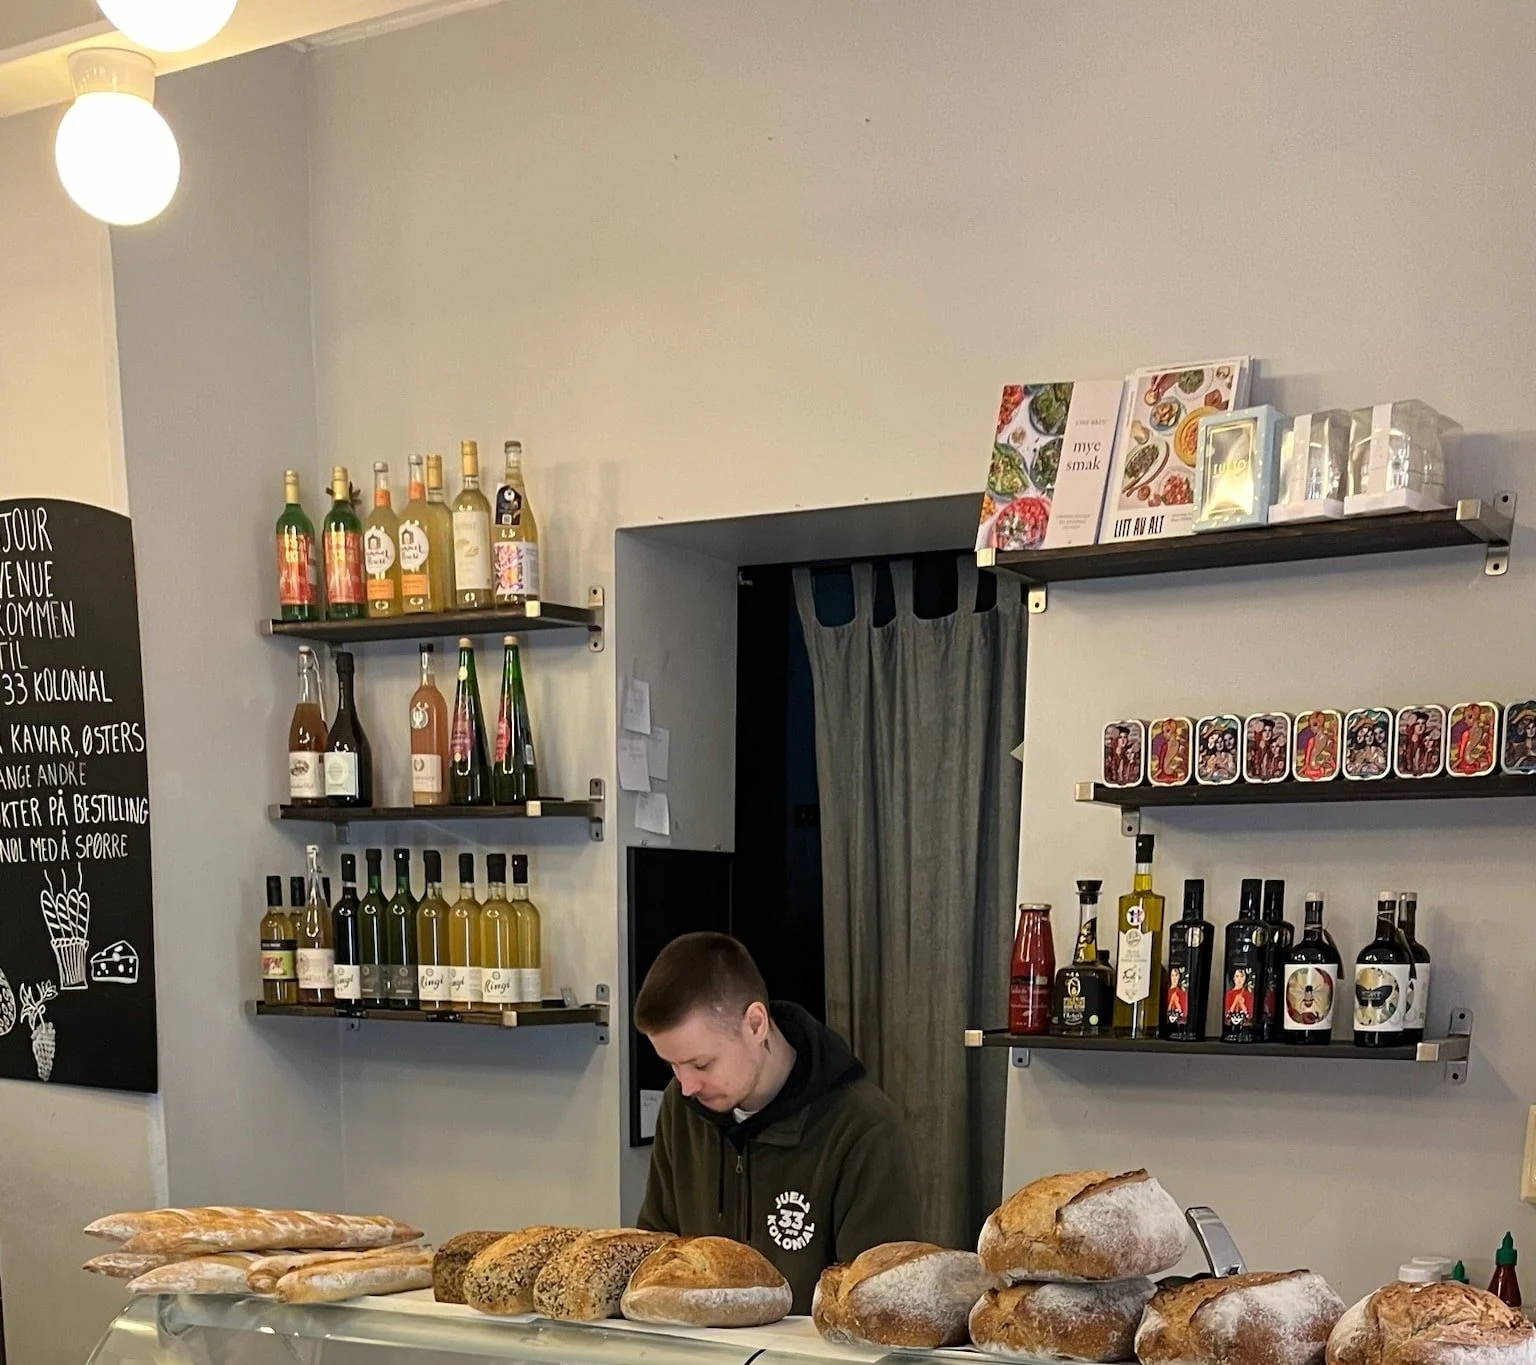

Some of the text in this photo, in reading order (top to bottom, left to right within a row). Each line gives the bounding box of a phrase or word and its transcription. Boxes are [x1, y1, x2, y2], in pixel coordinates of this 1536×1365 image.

[1066, 456, 1101, 471] smak
[1073, 441, 1102, 456] mye
[0, 506, 53, 553] JOUR
[1114, 518, 1132, 538] LITT
[1133, 516, 1147, 536] AV
[1148, 515, 1165, 534] ALT
[0, 600, 76, 640] OMMEN
[2, 665, 113, 706] 33 KOLONIAL
[10, 721, 145, 758] KAVIAR, ØSTERS
[37, 760, 87, 787] ANDRE
[48, 788, 69, 826] PÅ
[73, 793, 149, 825] BESTILLING
[30, 837, 58, 862] MED
[61, 829, 70, 860] Å
[75, 832, 128, 860] SPØRRE
[484, 978, 511, 993] Ringi
[775, 1191, 811, 1214] JUELS
[767, 1214, 815, 1251] KOLONIAL
[778, 1209, 805, 1230] 33
